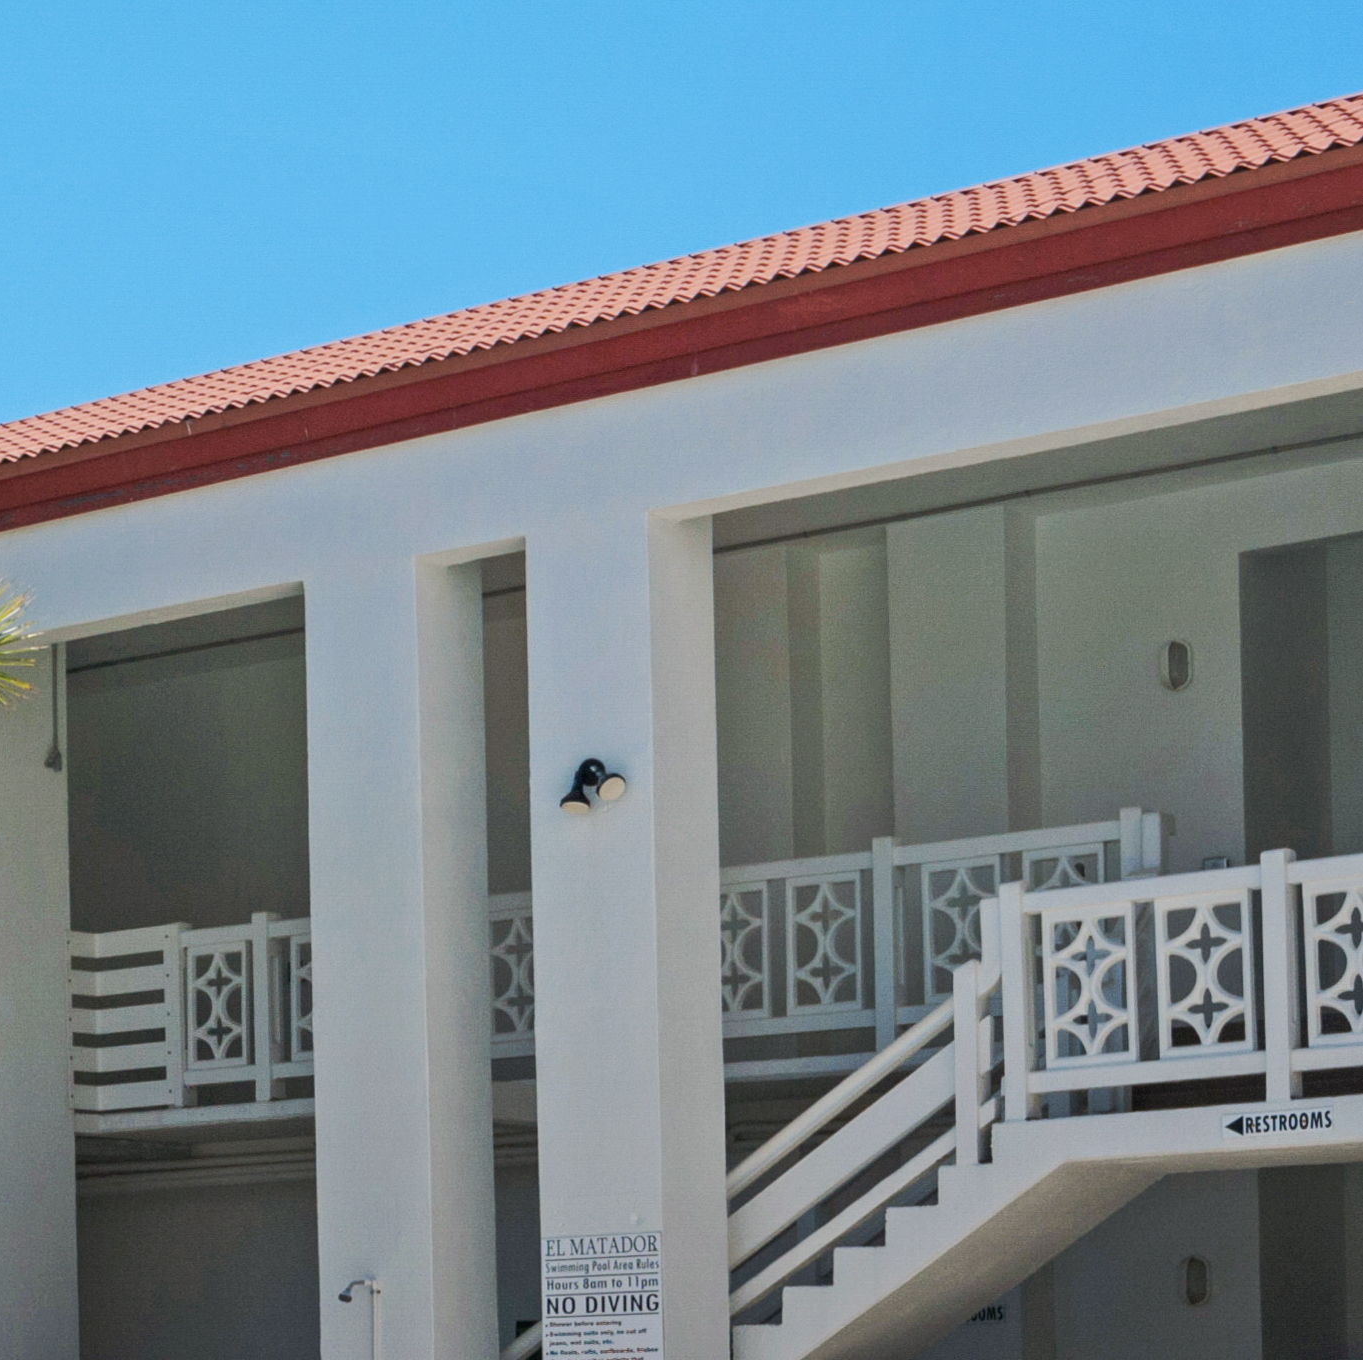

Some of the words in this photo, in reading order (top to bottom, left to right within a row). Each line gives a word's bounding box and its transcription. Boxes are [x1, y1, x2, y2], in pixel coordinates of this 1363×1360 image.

[1245, 1110, 1333, 1134] RESTROOMS
[546, 1239, 565, 1257] EL
[570, 1235, 659, 1256] MATADOR
[546, 1262, 589, 1274] Swimming
[592, 1260, 610, 1271] Pool
[613, 1259, 633, 1270] Area
[636, 1258, 659, 1269] Rules
[547, 1280, 579, 1290] Hours
[583, 1278, 607, 1289] 8am
[612, 1278, 622, 1288] to
[628, 1276, 659, 1289] 11pm
[546, 1296, 576, 1315] NO
[585, 1293, 659, 1313] DIVING
